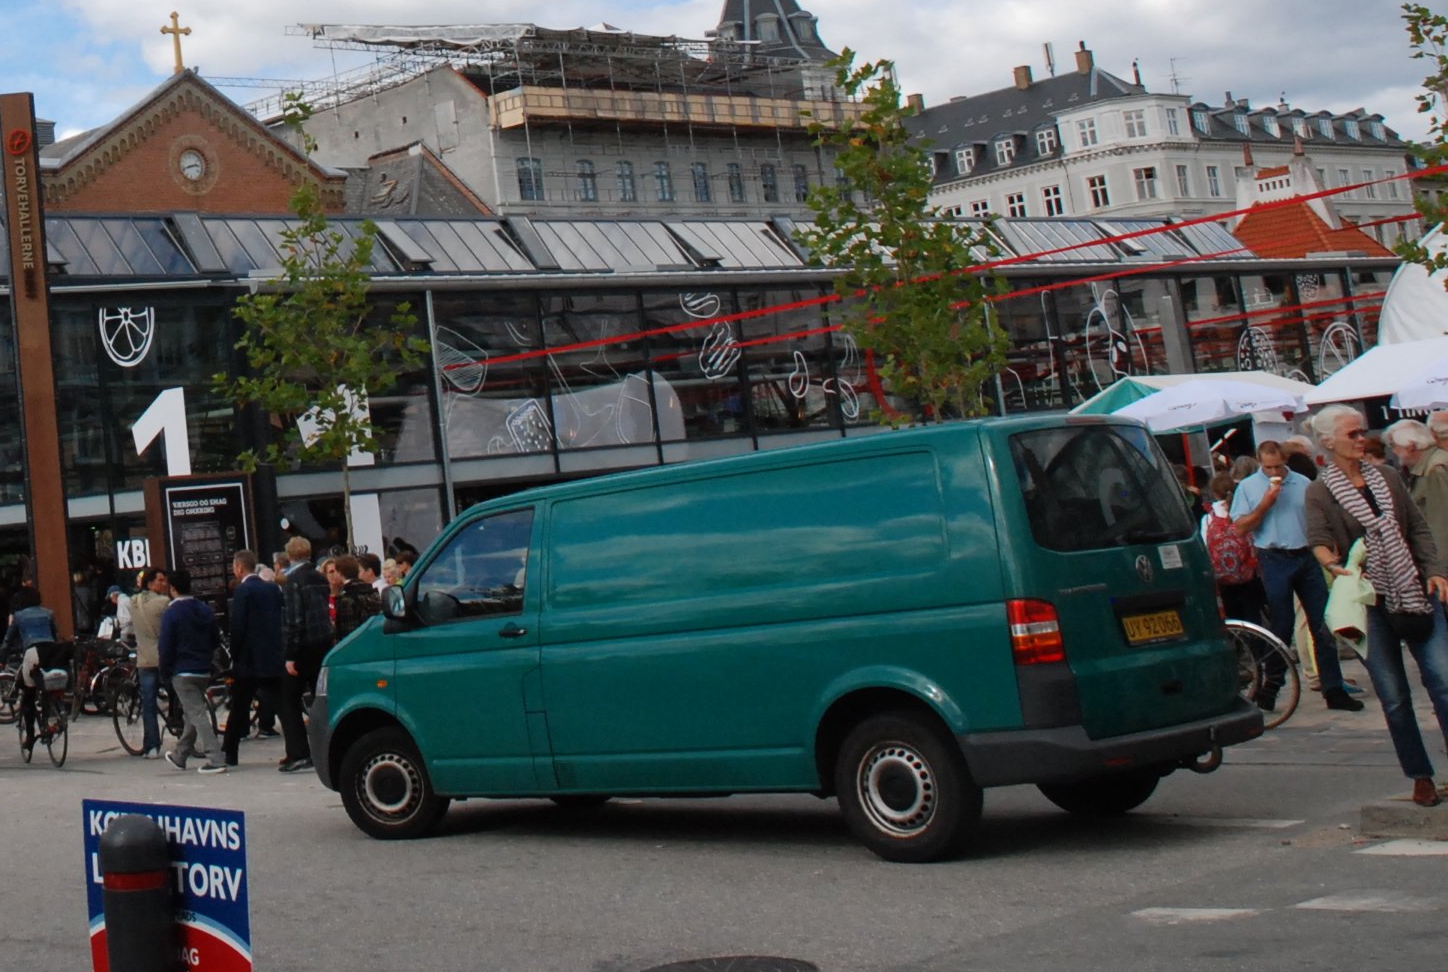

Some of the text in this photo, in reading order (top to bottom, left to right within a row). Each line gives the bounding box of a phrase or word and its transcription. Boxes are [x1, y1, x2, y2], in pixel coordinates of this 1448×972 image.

[12, 157, 35, 270] TORVEHALLERNE
[131, 386, 192, 477] 1
[89, 809, 241, 851] KHAVNS
